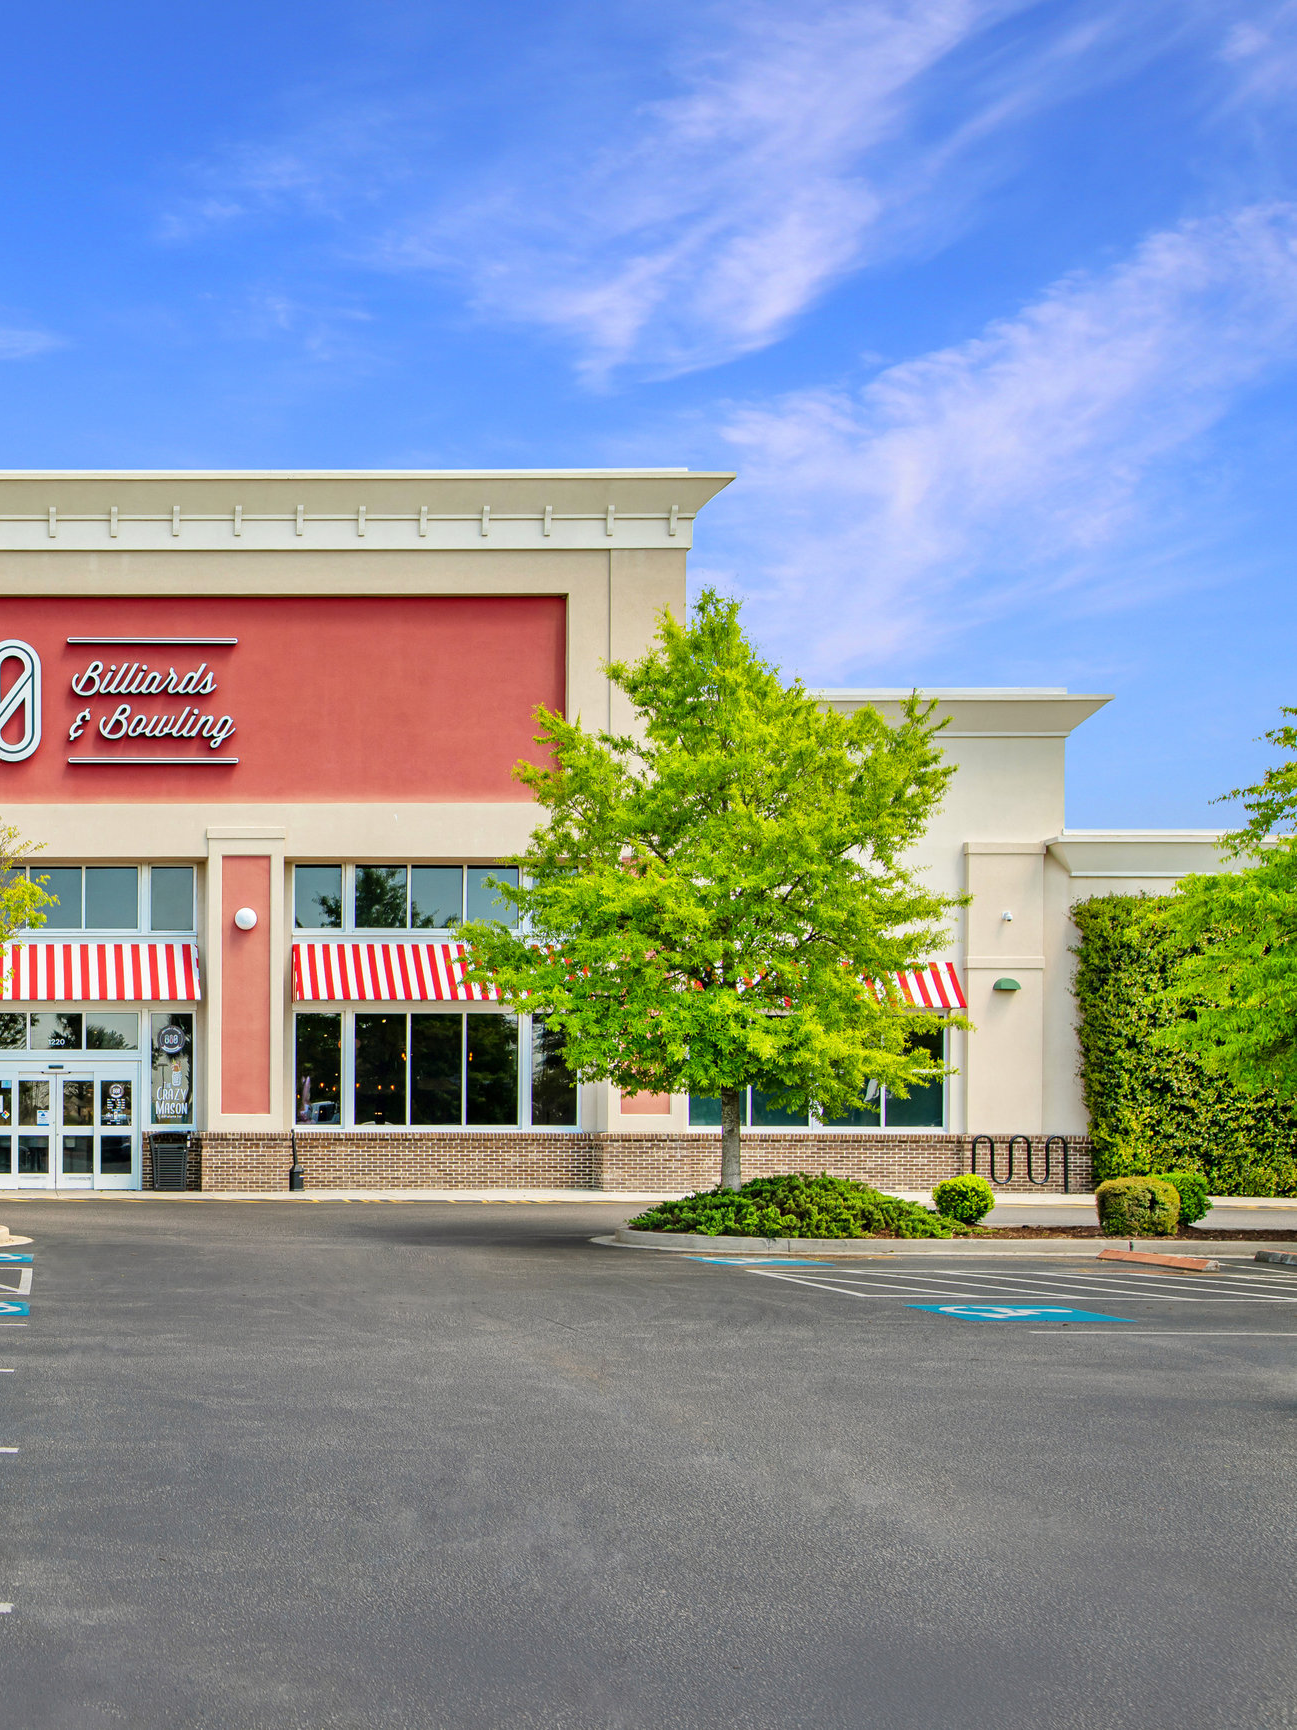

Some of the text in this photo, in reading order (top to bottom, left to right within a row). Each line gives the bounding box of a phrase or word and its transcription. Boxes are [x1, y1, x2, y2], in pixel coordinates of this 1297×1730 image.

[71, 660, 218, 697] Billiards
[69, 704, 236, 748] & Bowling
[48, 1038, 66, 1046] 1220
[156, 1086, 189, 1101] CRAZY
[155, 1100, 188, 1115] MASON
